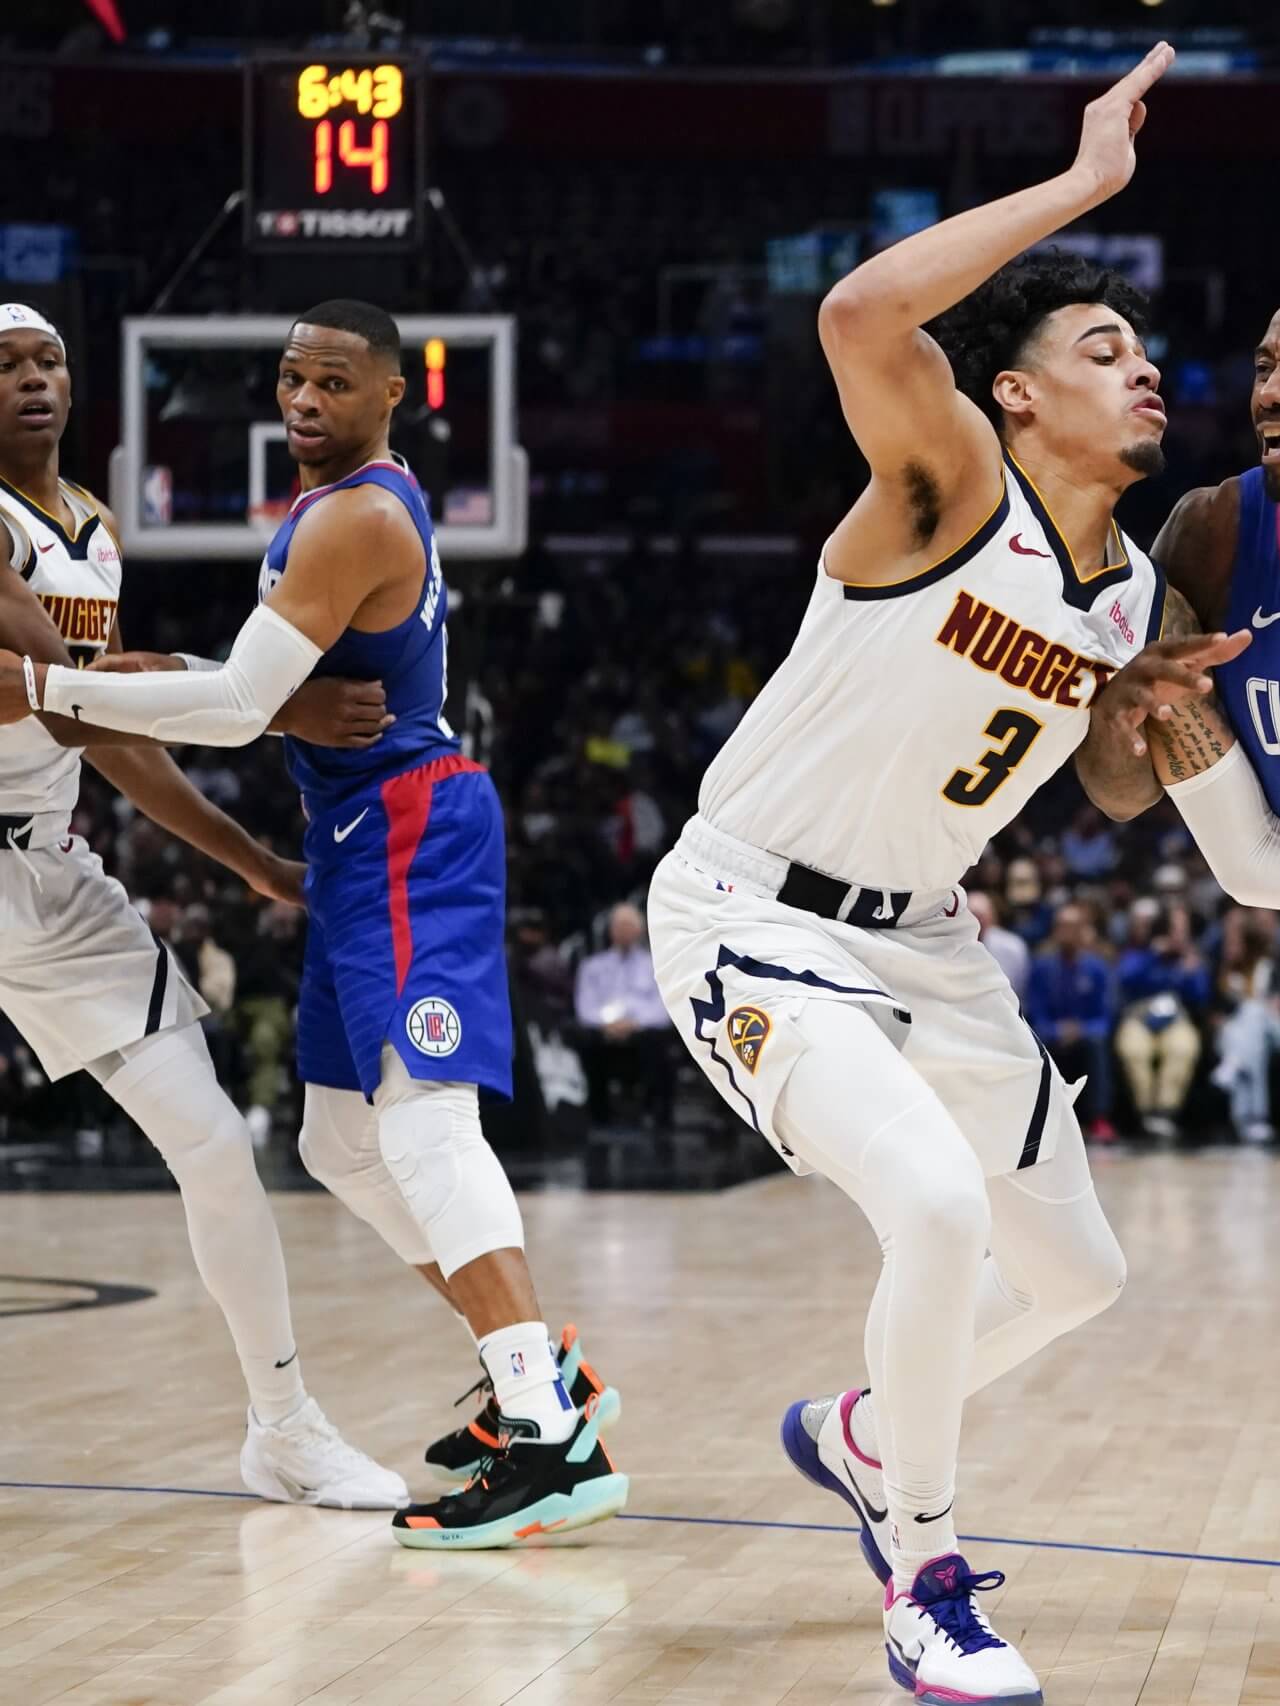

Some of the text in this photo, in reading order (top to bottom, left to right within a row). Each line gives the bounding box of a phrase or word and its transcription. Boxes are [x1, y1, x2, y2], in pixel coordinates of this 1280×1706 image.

[298, 65, 402, 119] 6:43
[315, 119, 388, 194] 14
[1109, 600, 1134, 645] ibotta
[941, 707, 1045, 806] 3
